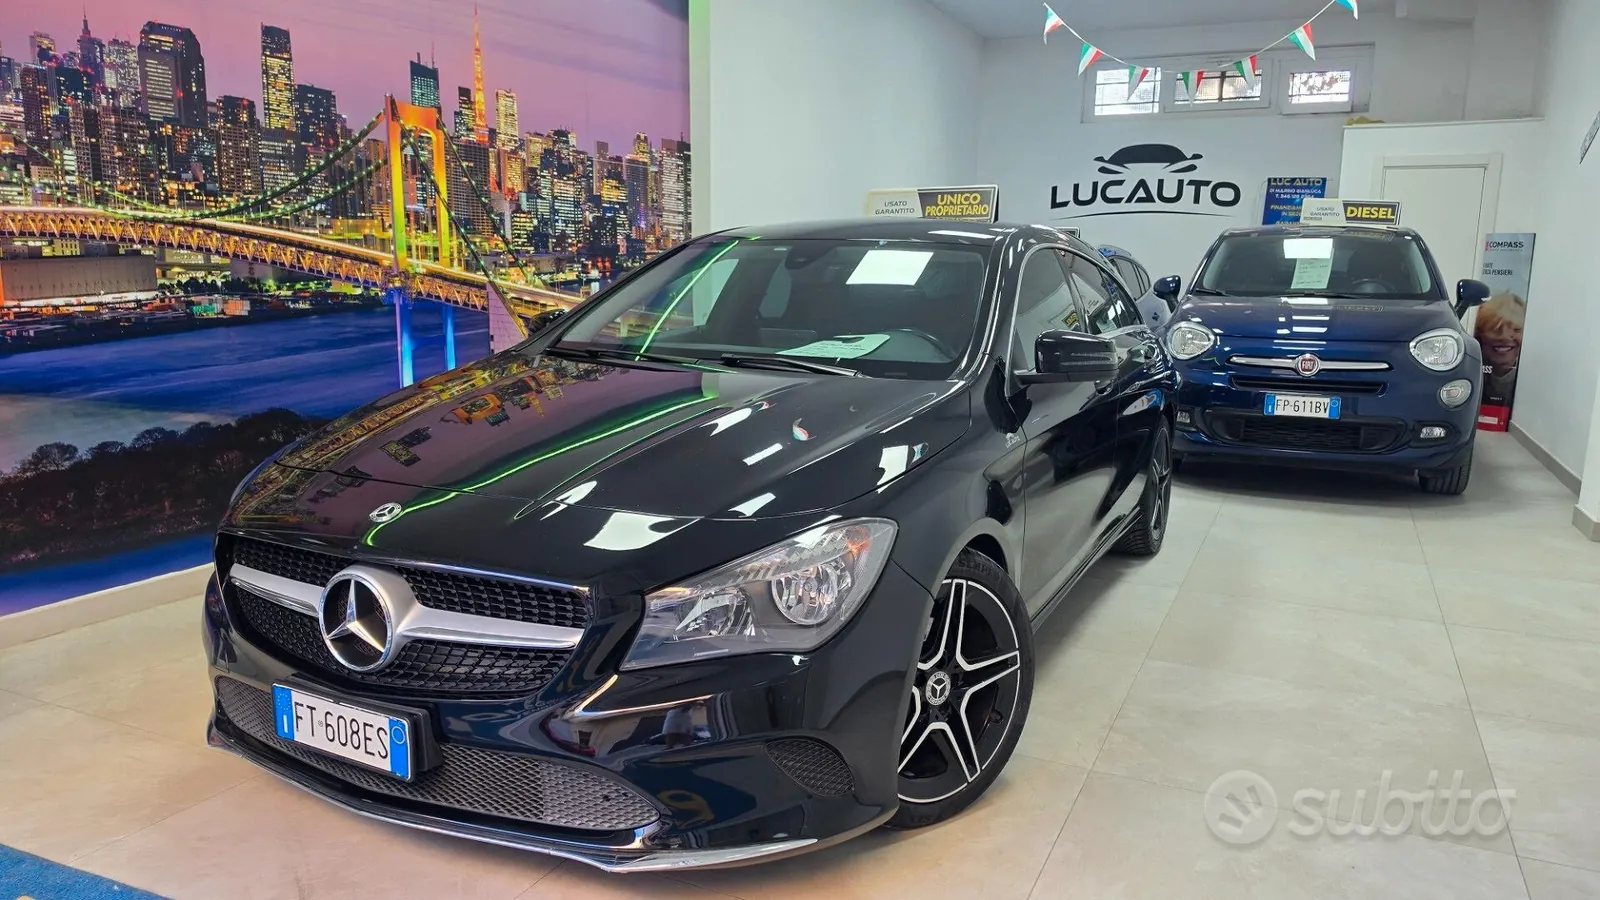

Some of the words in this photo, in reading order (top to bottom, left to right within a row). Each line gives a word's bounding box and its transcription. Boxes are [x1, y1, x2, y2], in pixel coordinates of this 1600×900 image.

[1270, 178, 1290, 186] LUC
[1293, 178, 1323, 186] AUTO
[937, 192, 981, 205] UNICO
[1050, 178, 1242, 210] LUCAUTO
[875, 207, 915, 215] GARANTITO
[925, 204, 989, 217] PROPRIETARIO
[1346, 206, 1395, 219] DIESEL
[1301, 361, 1314, 370] FIAT
